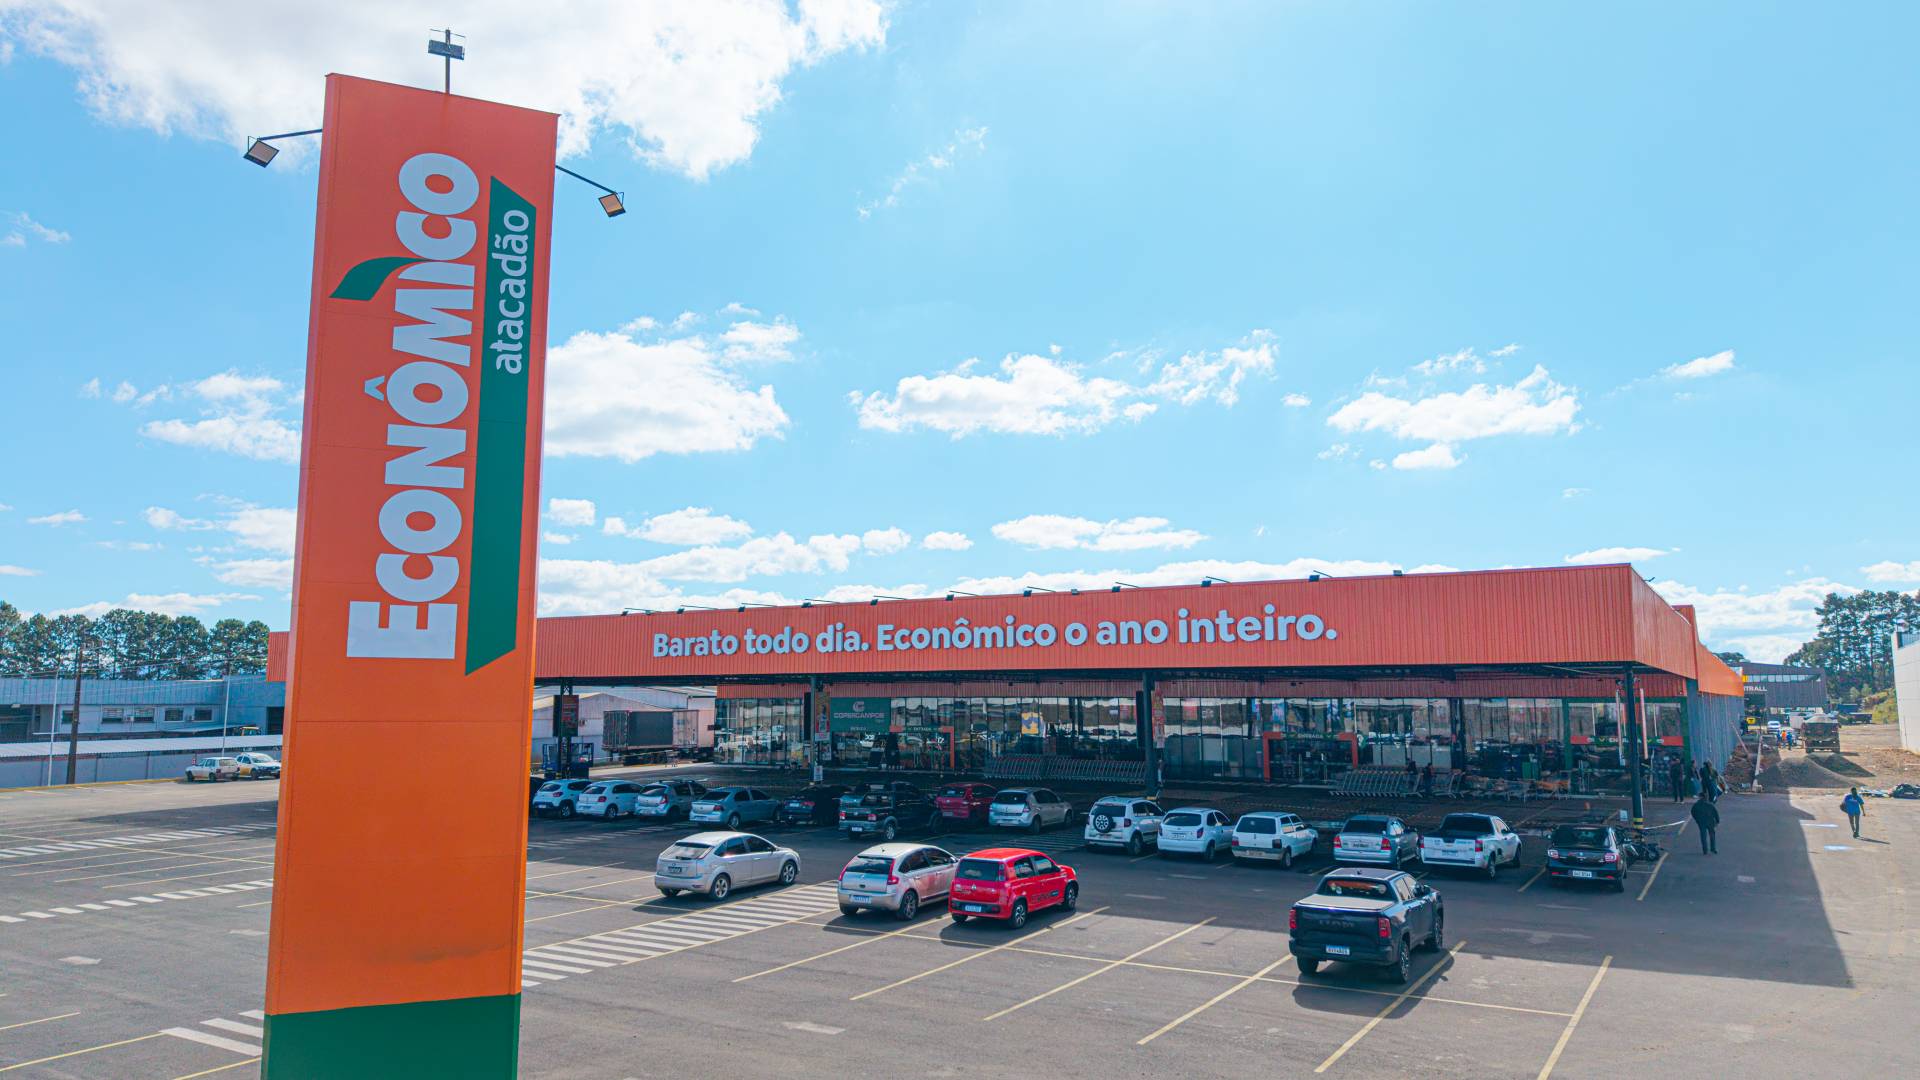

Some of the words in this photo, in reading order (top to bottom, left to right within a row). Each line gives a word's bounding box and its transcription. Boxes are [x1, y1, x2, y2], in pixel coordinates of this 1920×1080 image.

[490, 209, 530, 375] atacadão
[653, 629, 739, 657] Barato
[743, 625, 810, 655] todo
[815, 622, 870, 653] dia.
[876, 616, 1057, 651] Econômico
[1064, 622, 1089, 646] o
[1096, 619, 1169, 646] ano
[1177, 603, 1338, 644] inteiro.
